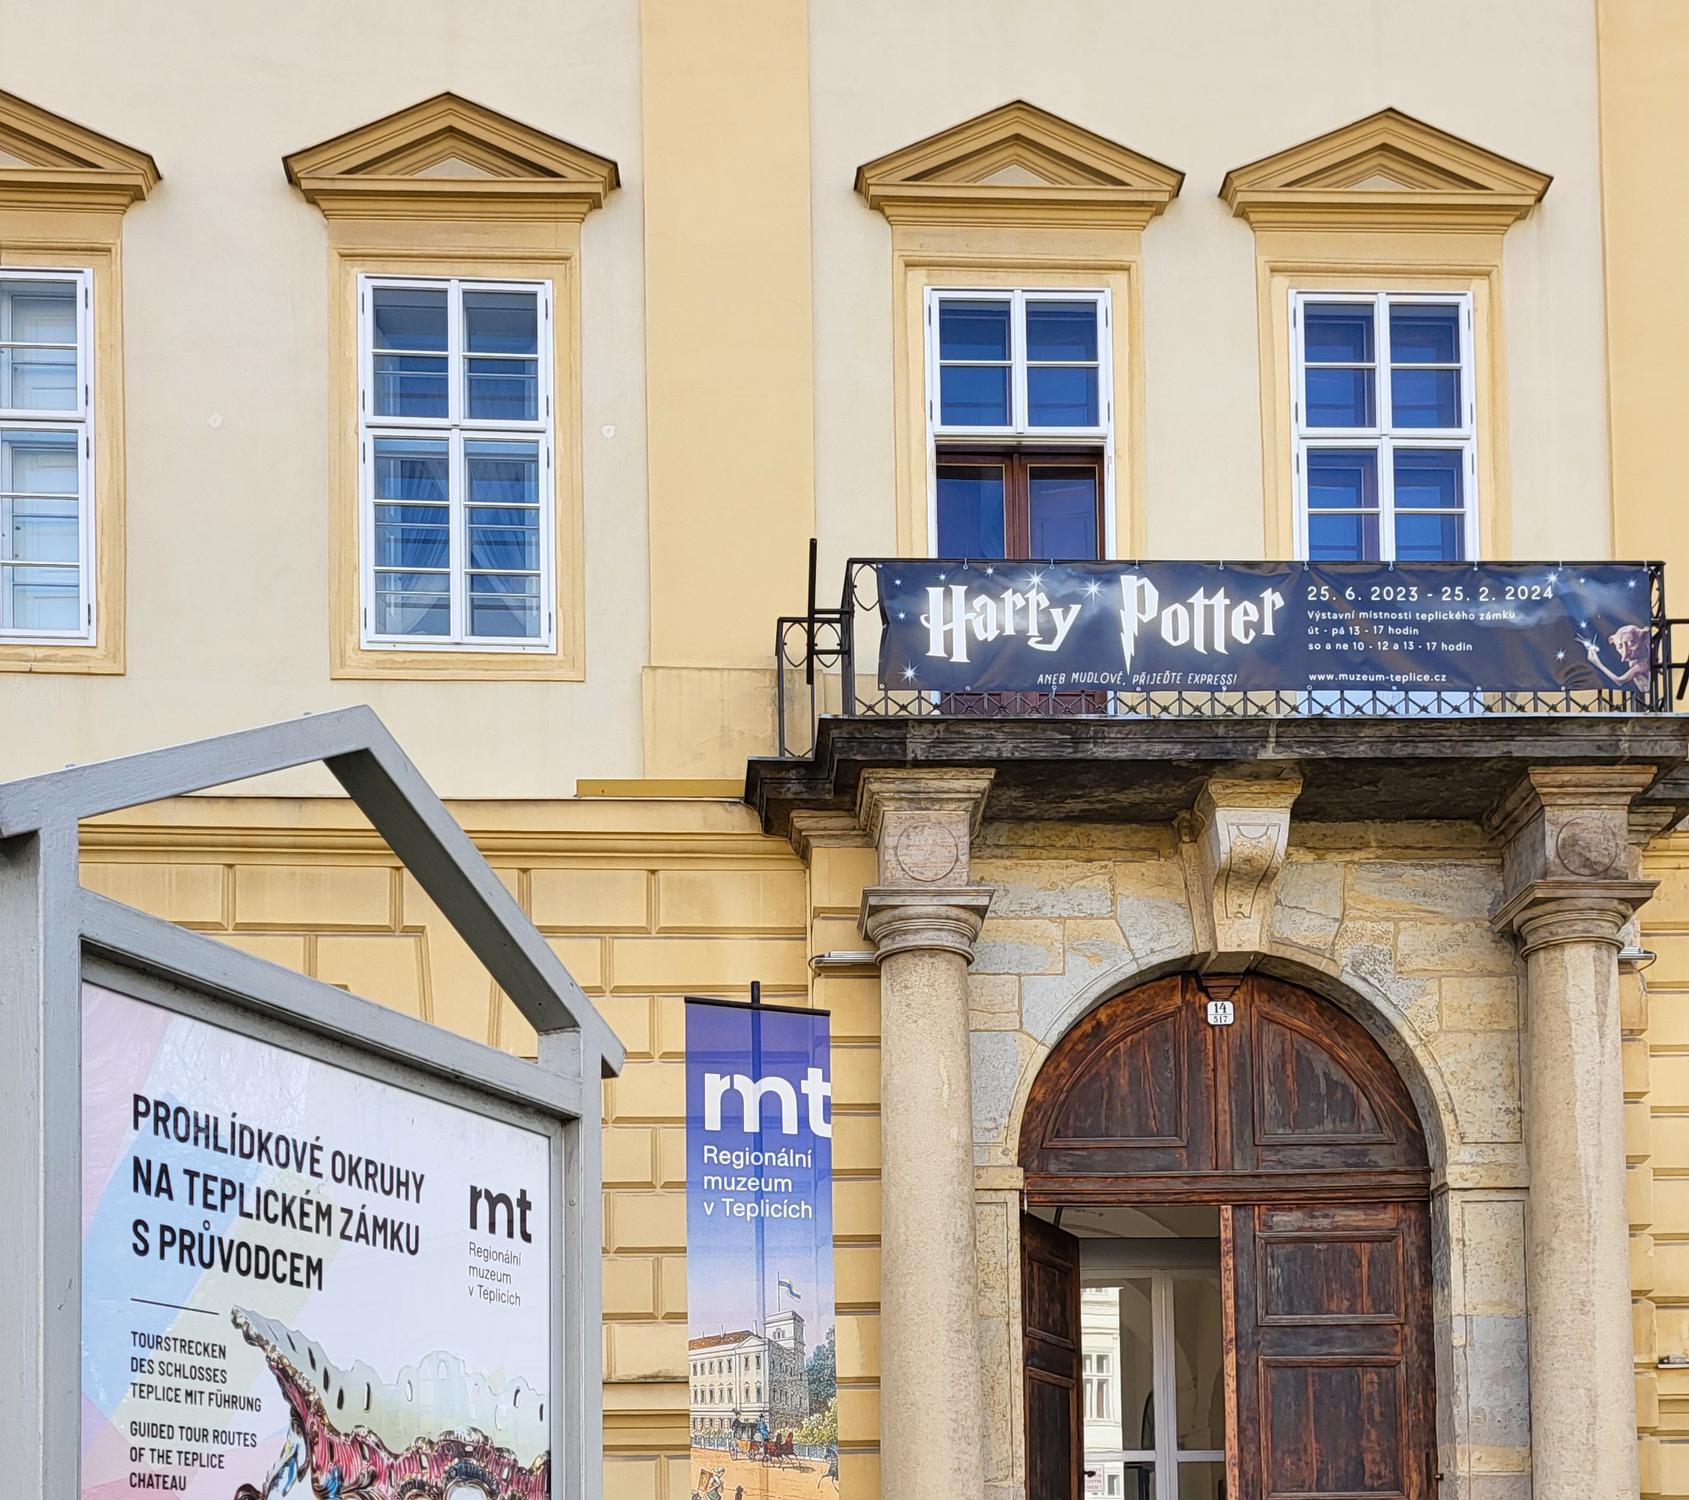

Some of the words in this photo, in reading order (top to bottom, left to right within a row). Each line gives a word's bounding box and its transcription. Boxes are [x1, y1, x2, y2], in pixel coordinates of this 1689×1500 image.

[1308, 586, 1336, 600] 25.
[1346, 587, 1362, 600] 6.
[1371, 587, 1418, 601] 2023
[1442, 587, 1469, 601] 25.
[1479, 587, 1494, 601] 2.
[1505, 586, 1553, 600] 2024
[920, 585, 1081, 662] Harry
[1120, 575, 1284, 675] Potter
[1308, 610, 1355, 620] Výstavní
[1359, 611, 1411, 620] místnosti
[1416, 611, 1475, 621] teplického
[1479, 610, 1515, 621] zámku
[1308, 626, 1319, 635] út
[1332, 626, 1344, 636] pá
[1349, 626, 1360, 635] 13
[1373, 626, 1384, 635] 17
[1389, 626, 1419, 635] hodin
[1353, 642, 1364, 650] 10
[1378, 642, 1389, 650] 12
[1404, 642, 1414, 650] 13
[1427, 642, 1437, 651] 17
[1442, 642, 1472, 651] hodin
[1038, 674, 1065, 686] ANEB
[1071, 671, 1126, 686] MUDLOVÉ,
[1132, 670, 1183, 686] PŘIJEĎTE
[1188, 672, 1237, 686] EXPRESS!
[1309, 672, 1446, 683] www.muzeum-teplice.cz
[1214, 1003, 1226, 1013] 14
[132, 1093, 321, 1179] PROHLÍDKOVÉ
[331, 1151, 425, 1204] OKRUHY
[704, 1145, 812, 1169] Regionální
[704, 1175, 792, 1192] muzeum
[132, 1156, 173, 1201] NA
[183, 1169, 331, 1237] TEPLICKÉM
[340, 1204, 419, 1255] ZÁMKU
[704, 1201, 714, 1216] v
[721, 1198, 812, 1221] Teplicích
[132, 1219, 149, 1256] S
[160, 1221, 323, 1291] PRŮVODCEM
[469, 1242, 521, 1266] Regionální
[469, 1266, 511, 1284] muzeum
[469, 1286, 474, 1296] v
[478, 1285, 520, 1306] Teplicích
[131, 1331, 226, 1359] TOURSTRECKEN
[131, 1357, 154, 1374] DES
[159, 1361, 227, 1384] SCHLOSSES
[131, 1383, 181, 1403] TEPLICE
[185, 1389, 205, 1406] MIT
[209, 1389, 261, 1412] FÜHRUNG
[130, 1421, 174, 1440] GUIDED
[178, 1426, 209, 1443] TOUR
[213, 1429, 257, 1447] ROUTES
[130, 1447, 145, 1462] OF
[149, 1448, 172, 1465] THE
[177, 1451, 224, 1469] TEPLICE
[130, 1472, 186, 1490] CHATEAU
